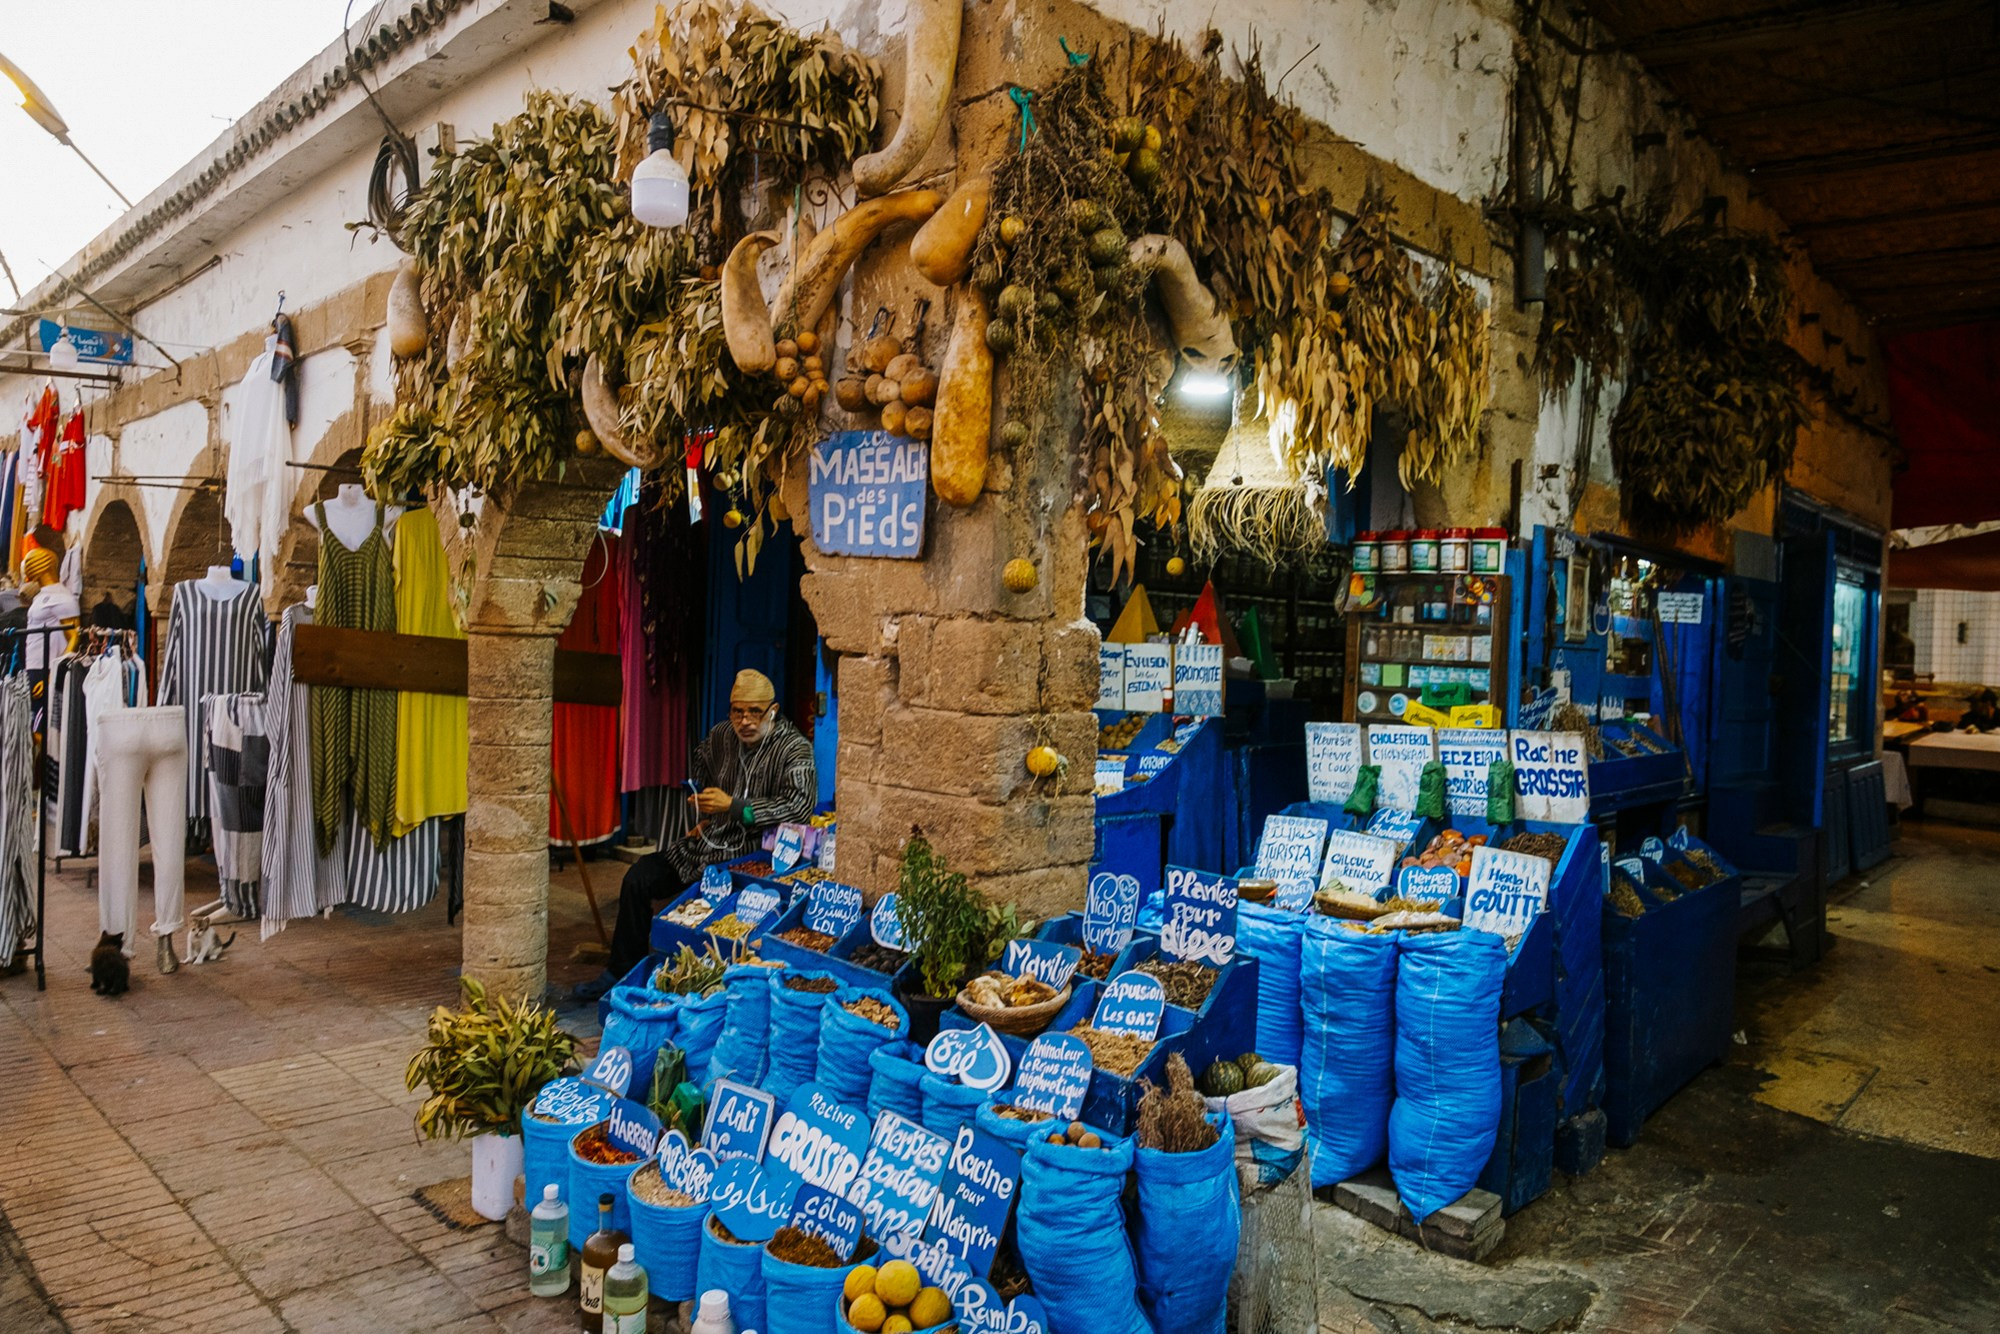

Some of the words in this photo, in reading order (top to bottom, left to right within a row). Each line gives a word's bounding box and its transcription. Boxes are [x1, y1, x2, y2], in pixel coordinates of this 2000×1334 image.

[856, 486, 887, 504] des
[1167, 870, 1238, 909] Plantes
[811, 917, 836, 936] LDL
[1102, 1004, 1125, 1023] Les
[1125, 1010, 1155, 1026] GAZ
[716, 1096, 761, 1133] Anti
[948, 1124, 1013, 1199] Racine
